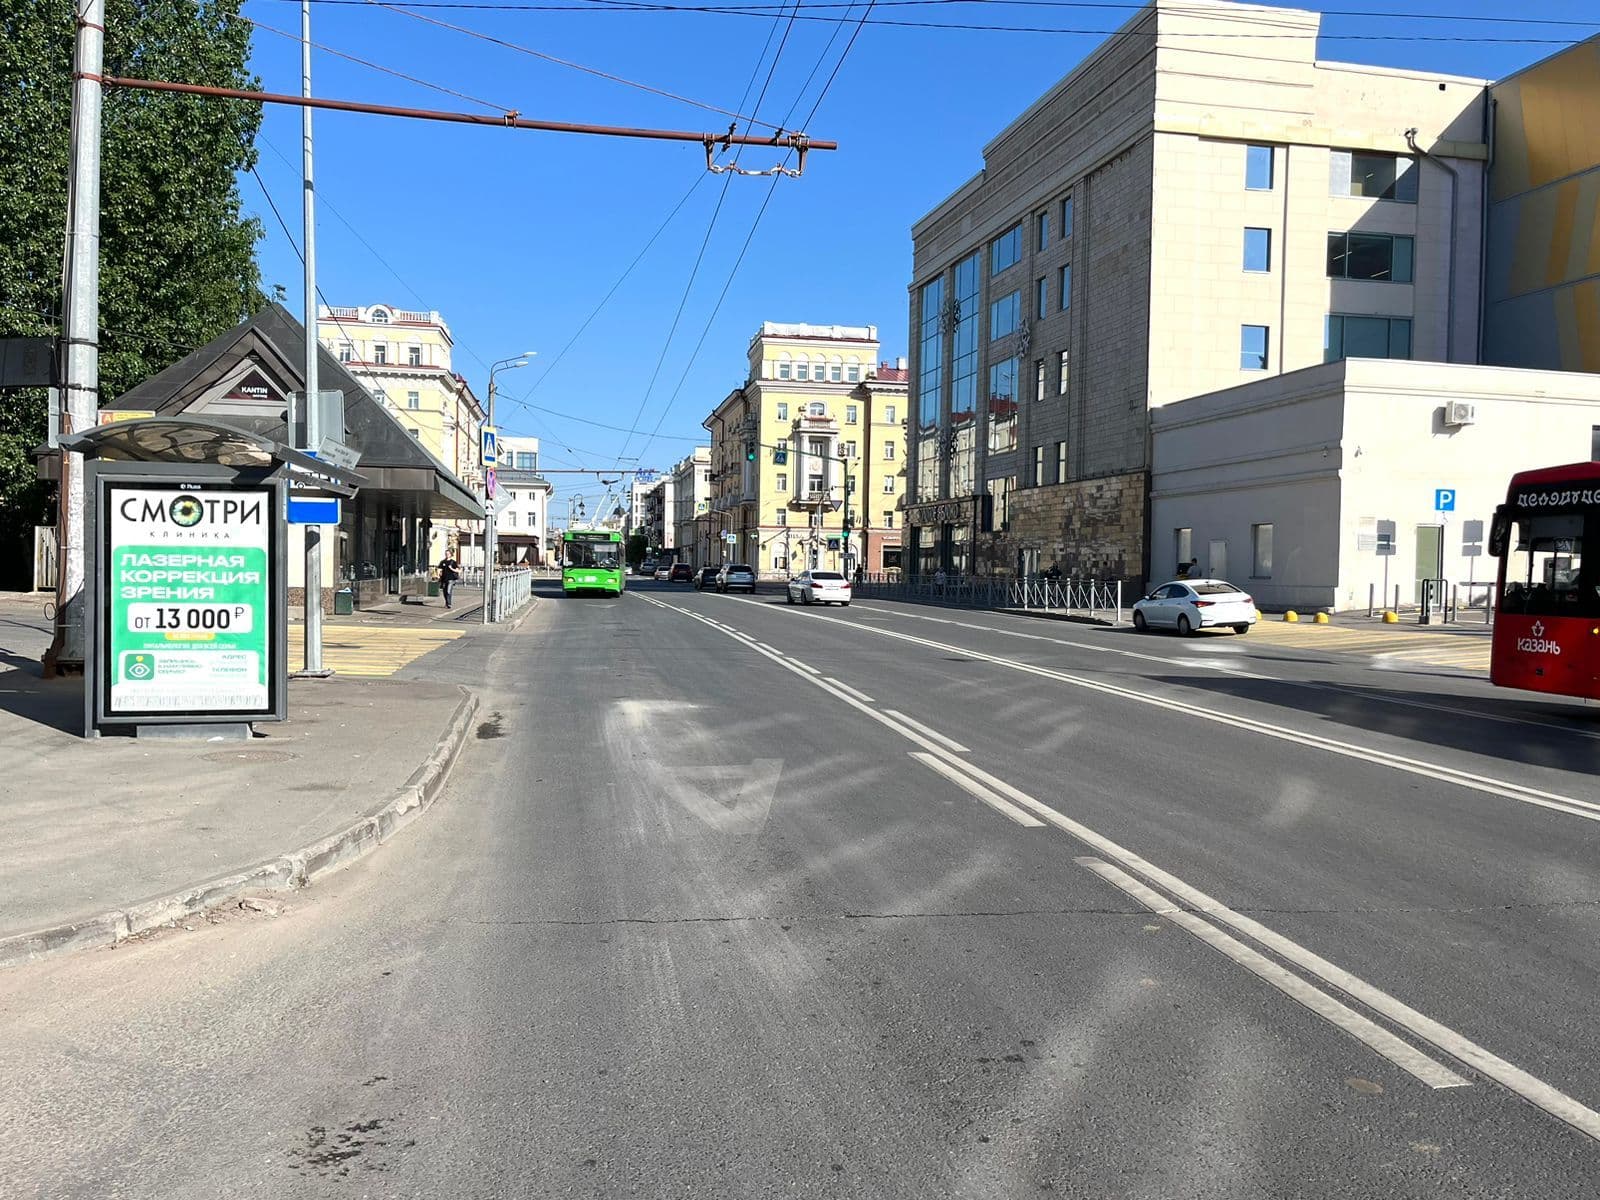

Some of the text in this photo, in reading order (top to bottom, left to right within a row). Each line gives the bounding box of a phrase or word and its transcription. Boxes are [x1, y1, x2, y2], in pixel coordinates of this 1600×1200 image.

[241, 386, 268, 394] KANTIN
[1440, 491, 1452, 509] P
[120, 494, 261, 527] СМОТРИ
[149, 531, 230, 539] КЛИНИКА
[120, 553, 245, 568] ЛАЗЕРНАЯ
[120, 569, 260, 585] КОРРЕКЦИЯ
[121, 586, 214, 600] ЗРЕНИЯ
[156, 608, 181, 629] 13
